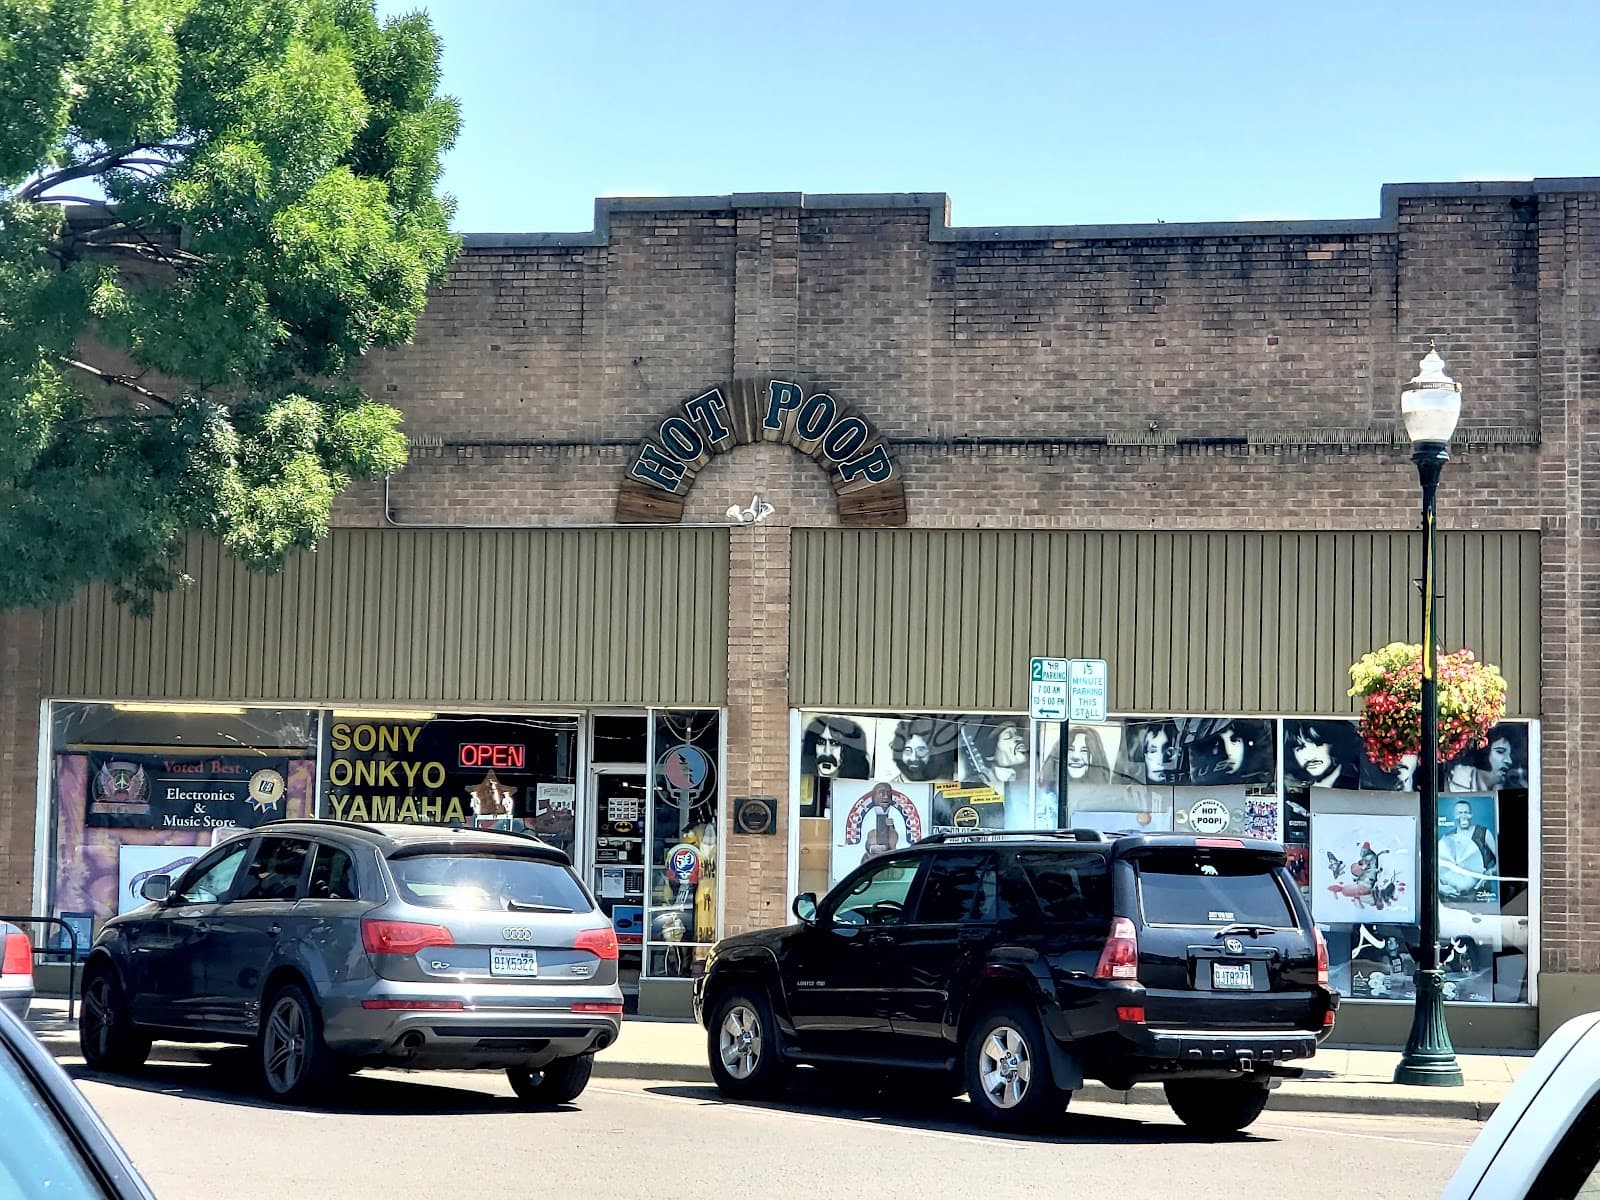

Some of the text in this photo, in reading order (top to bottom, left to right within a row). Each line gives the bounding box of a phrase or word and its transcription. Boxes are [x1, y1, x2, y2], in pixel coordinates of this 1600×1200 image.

[631, 379, 893, 493] HOT POOP
[1032, 662, 1042, 678] 2
[1049, 662, 1059, 670] HR
[1043, 671, 1066, 680] PARKING
[1072, 677, 1103, 686] MINUTE
[1053, 686, 1061, 694] AM
[1072, 687, 1103, 696] PARKING
[1033, 696, 1040, 705] TO
[1057, 697, 1065, 706] PM
[1078, 697, 1097, 706] THIS
[1074, 708, 1101, 717] STALL
[331, 723, 423, 753] SONY
[461, 744, 524, 767] OPEN
[163, 760, 241, 774] Voted Best
[329, 759, 446, 789] ONKYO
[166, 788, 236, 801] Electronics
[193, 802, 207, 814] &
[328, 794, 466, 823] YAMAHA
[163, 815, 236, 828] Music Store
